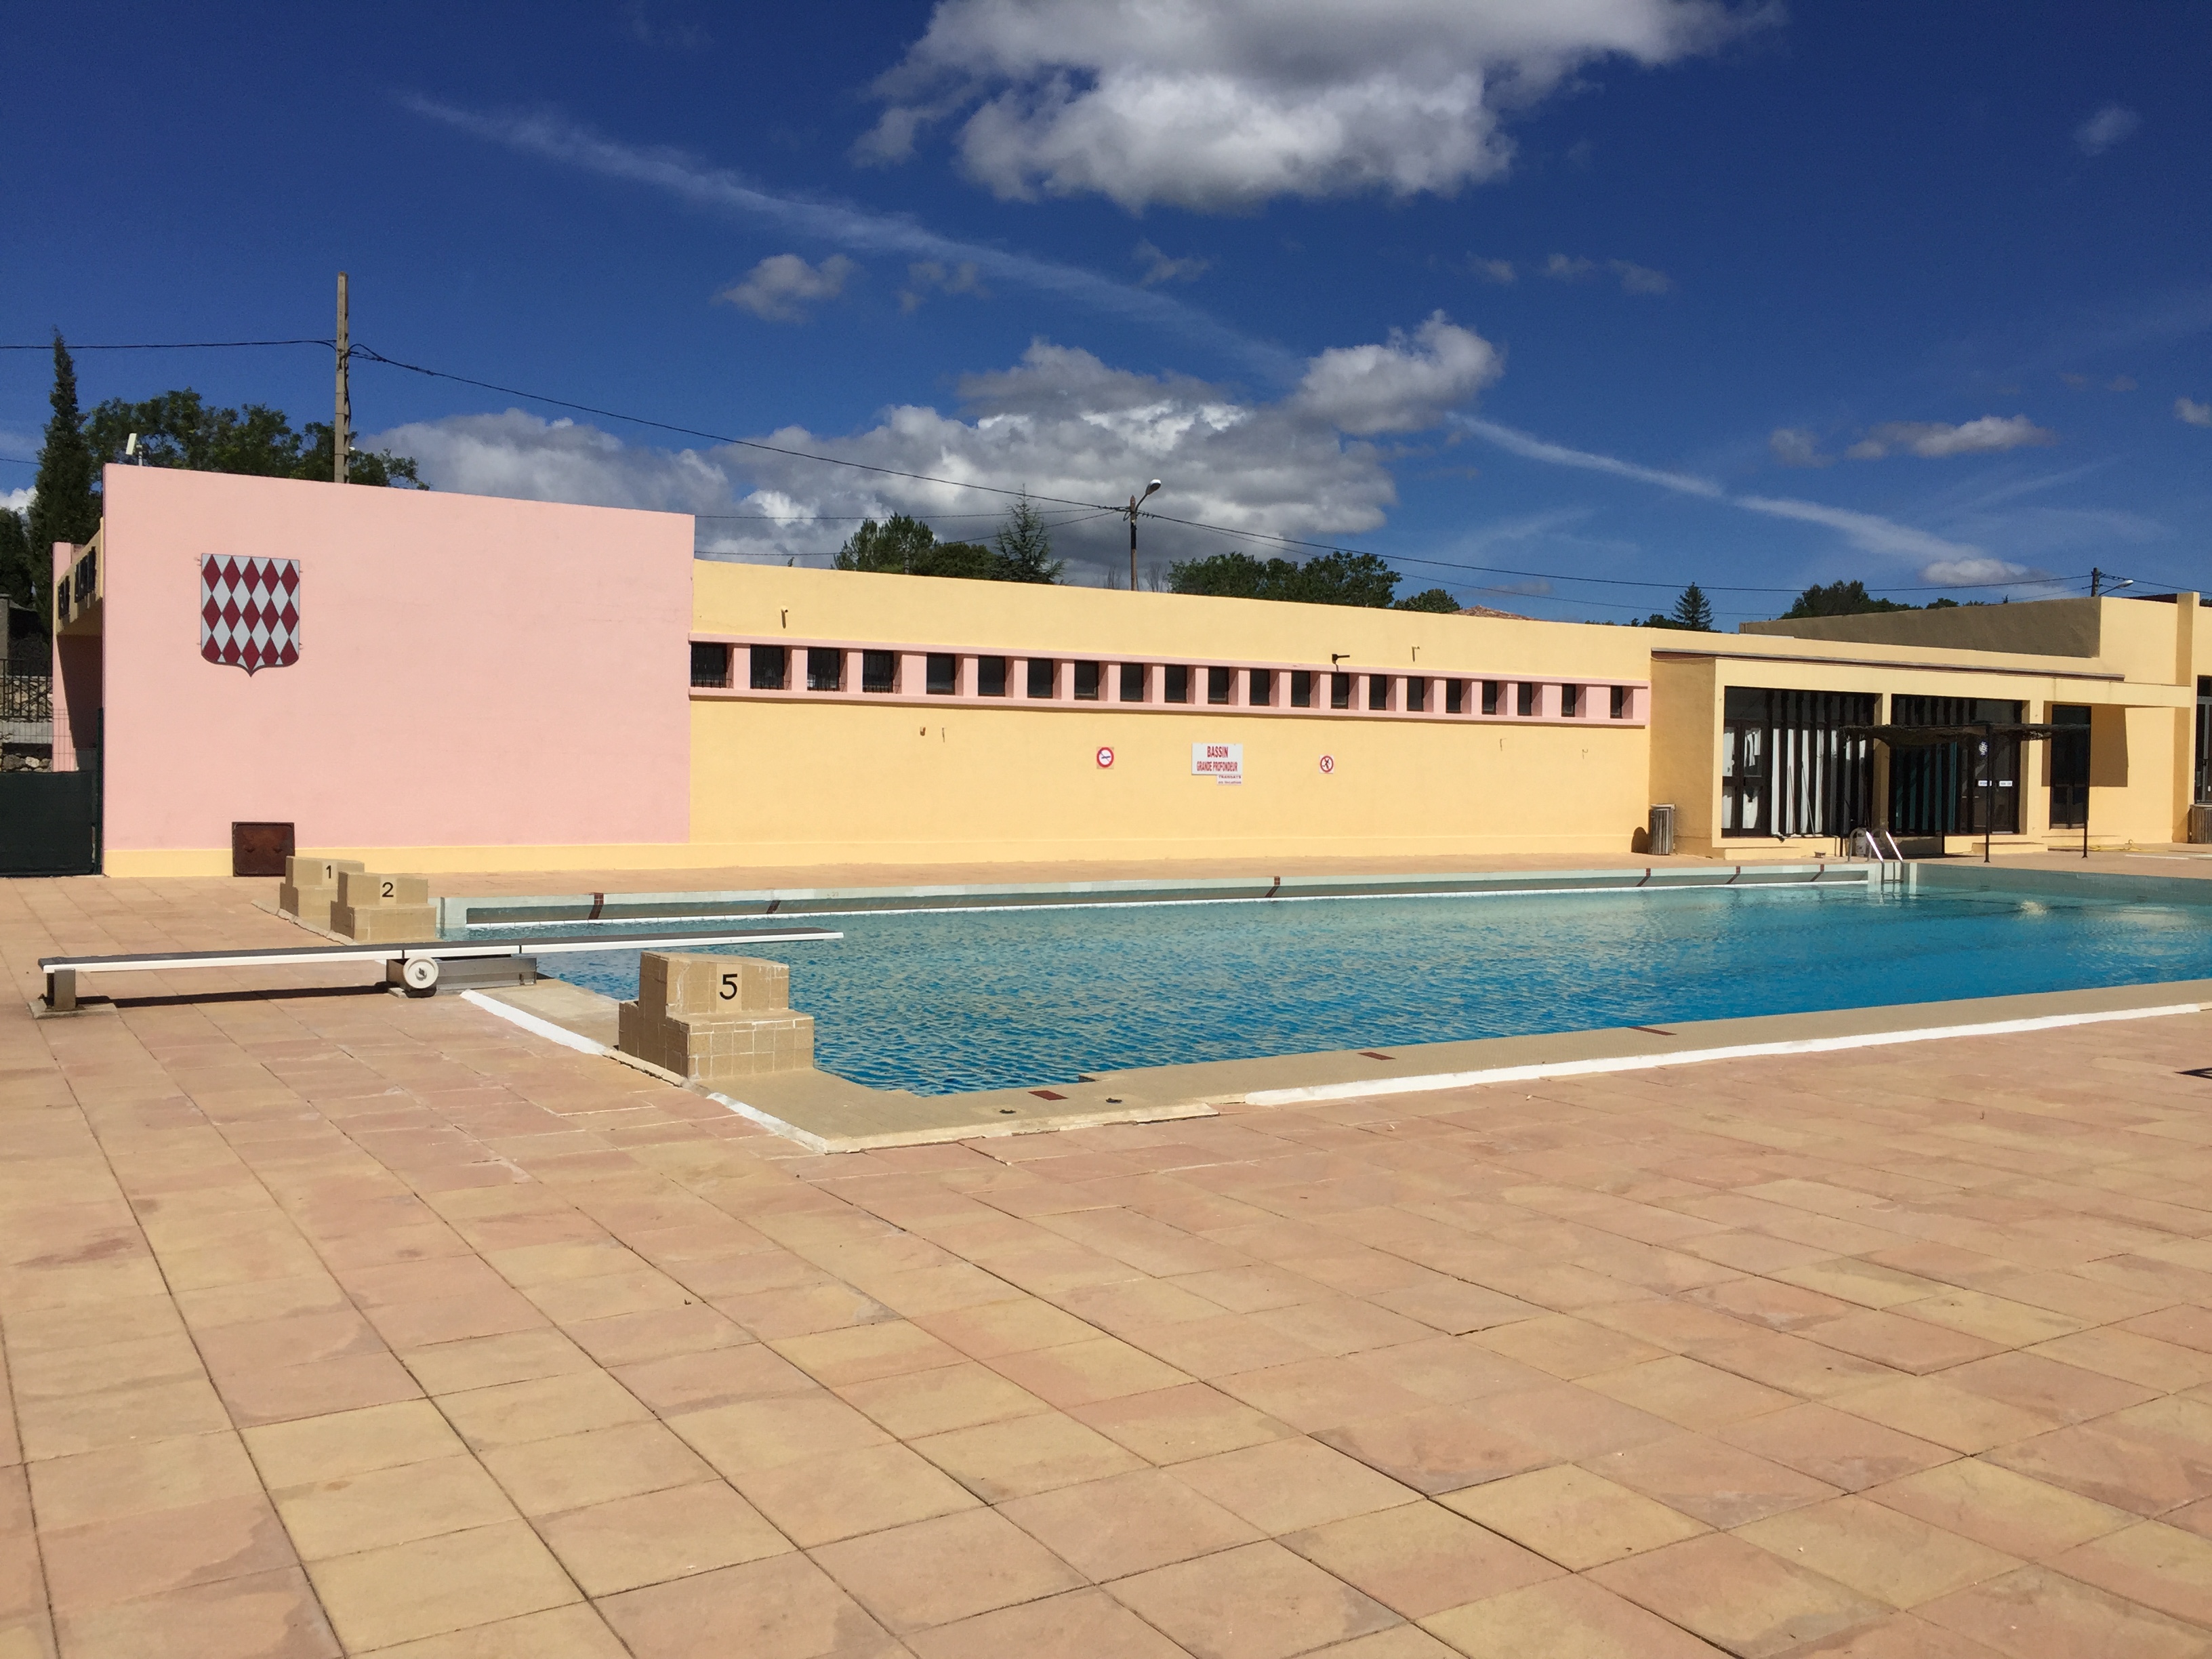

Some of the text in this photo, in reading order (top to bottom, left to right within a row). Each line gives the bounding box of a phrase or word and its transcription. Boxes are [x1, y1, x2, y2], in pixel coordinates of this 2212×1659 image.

[1207, 745, 1229, 758] BASSIN
[1197, 761, 1237, 771] GRANDE PROFONDEUR
[326, 865, 331, 879] 1
[382, 882, 394, 898] 2
[719, 973, 738, 1000] 5
